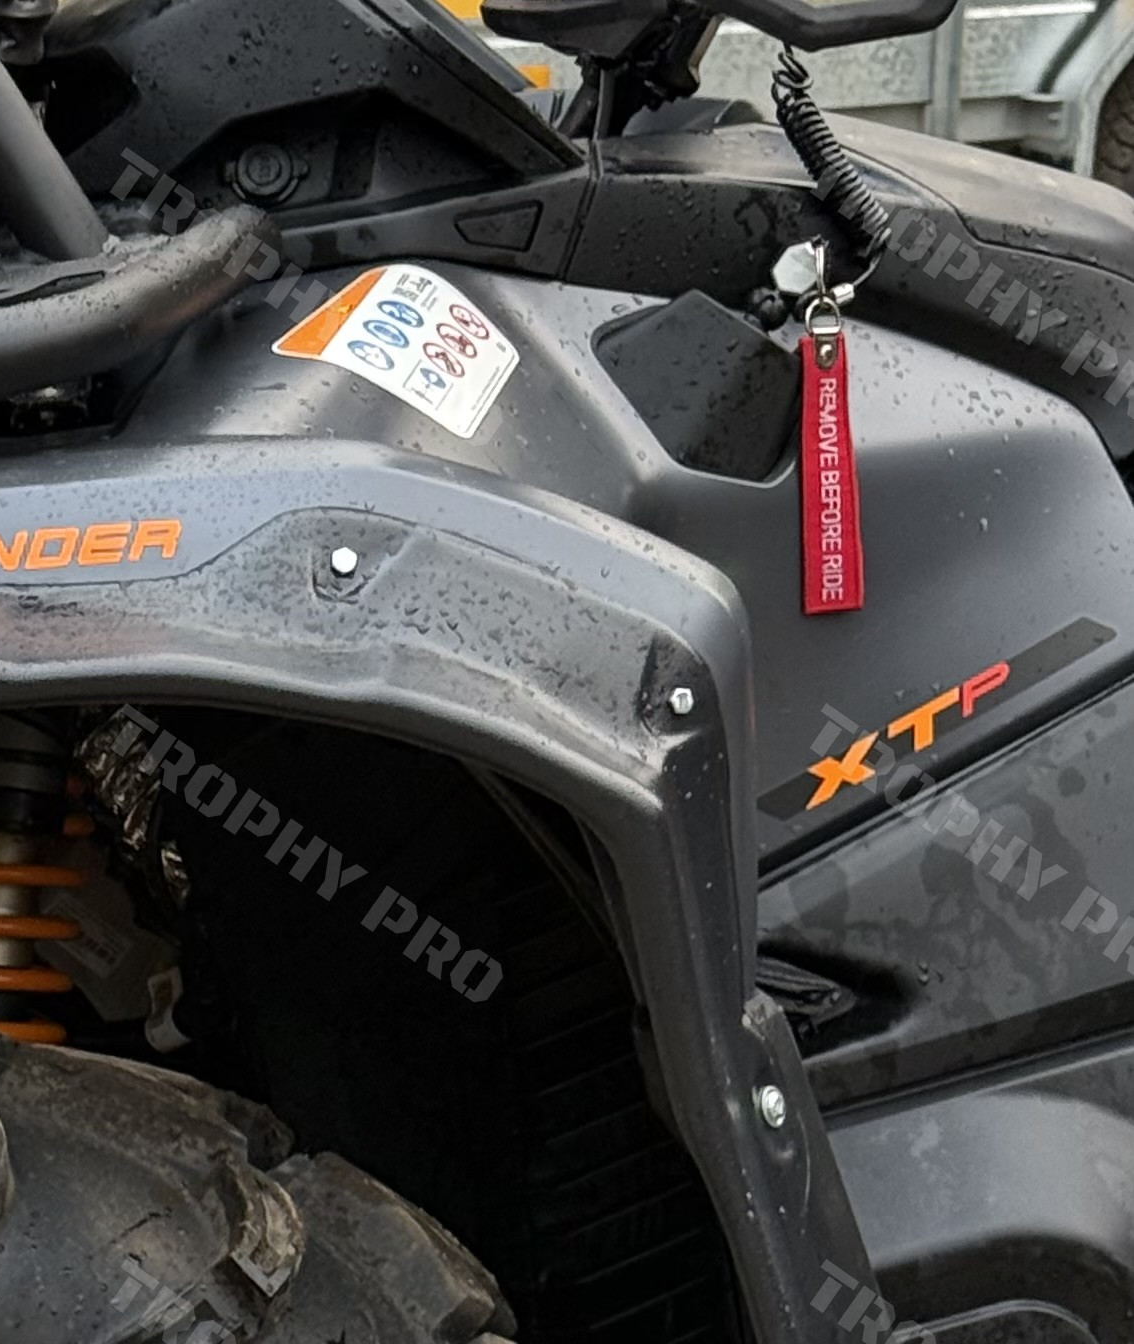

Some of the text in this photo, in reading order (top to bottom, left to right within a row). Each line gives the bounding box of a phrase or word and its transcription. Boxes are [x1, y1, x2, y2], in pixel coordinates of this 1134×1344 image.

[818, 377, 844, 603] REMOVE BEFORE RIDE
[806, 661, 1011, 810] XTP
